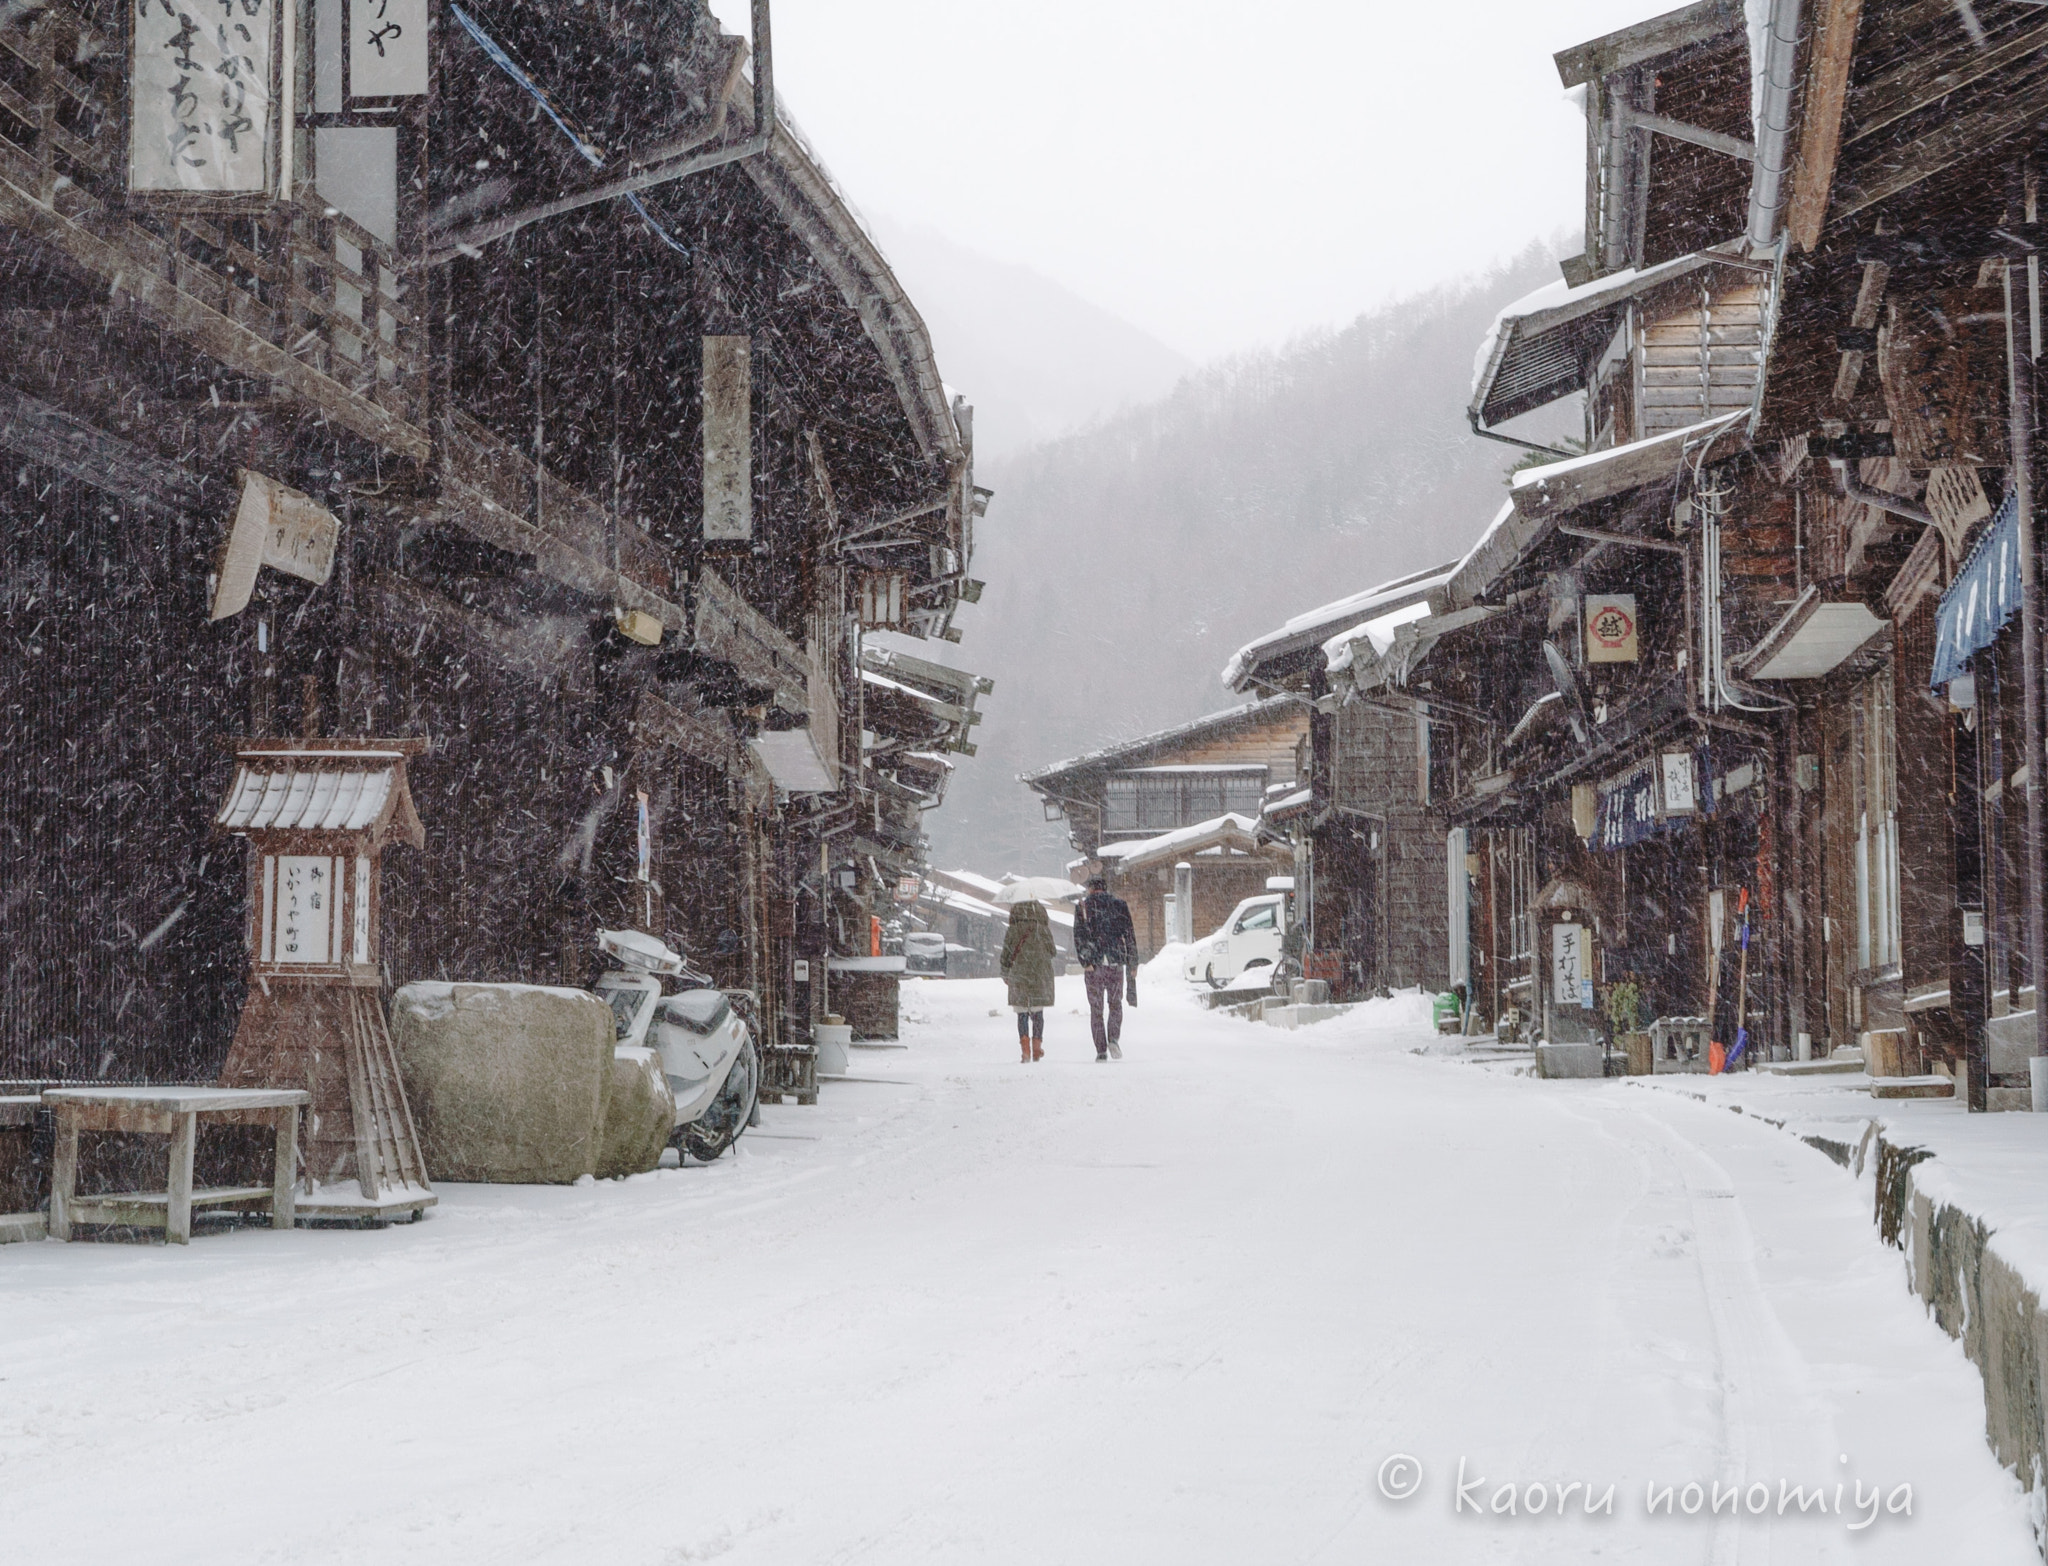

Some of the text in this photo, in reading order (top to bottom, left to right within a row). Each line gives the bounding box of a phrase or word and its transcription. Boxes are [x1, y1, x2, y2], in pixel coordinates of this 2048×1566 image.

[285, 867, 301, 953] いかりや町田
[310, 866, 324, 910] 御宿
[1558, 932, 1580, 1001] 手打そば
